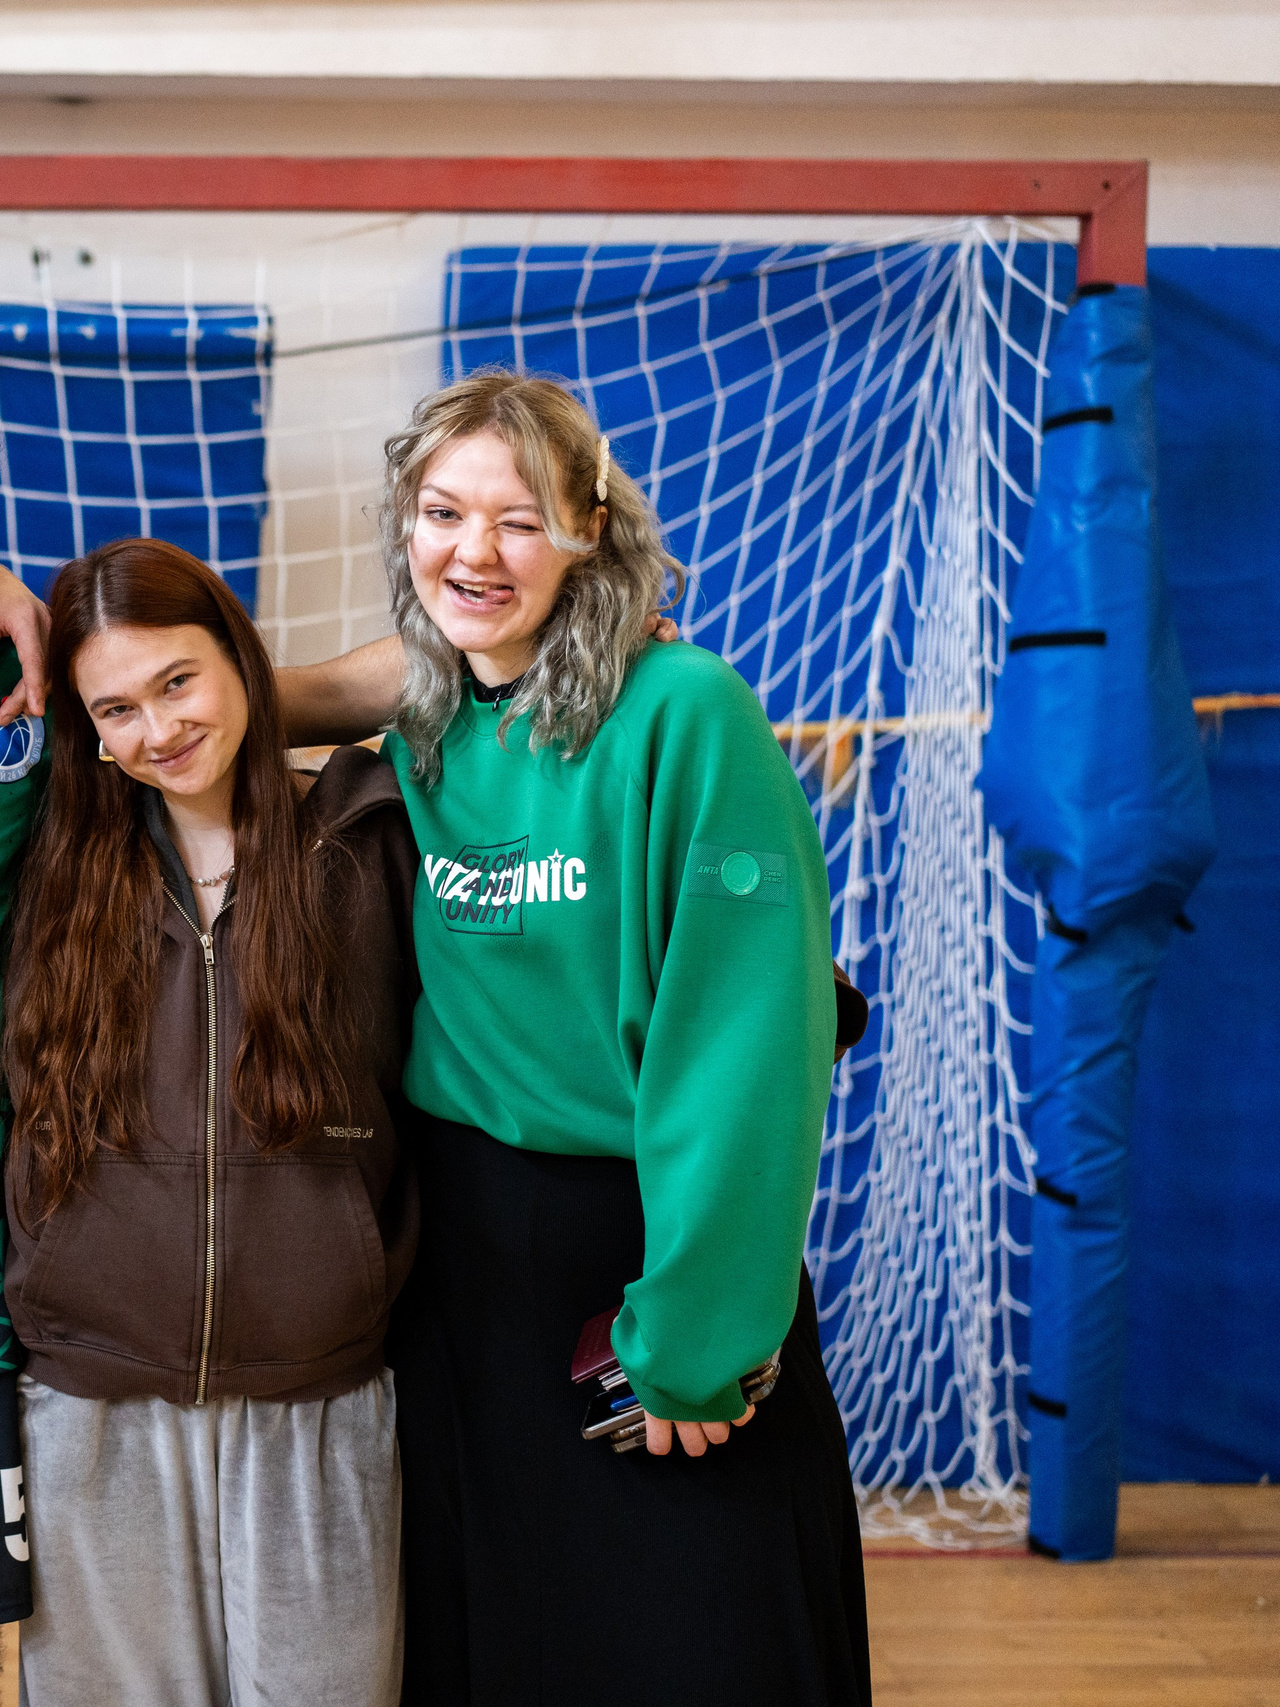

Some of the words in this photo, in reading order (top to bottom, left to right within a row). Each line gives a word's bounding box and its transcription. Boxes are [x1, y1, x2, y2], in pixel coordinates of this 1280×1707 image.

[7, 771, 17, 780] 26
[460, 847, 526, 874] GLORY
[462, 877, 514, 898] AND
[445, 899, 515, 925] UNITY
[0, 1464, 30, 1562] 5
